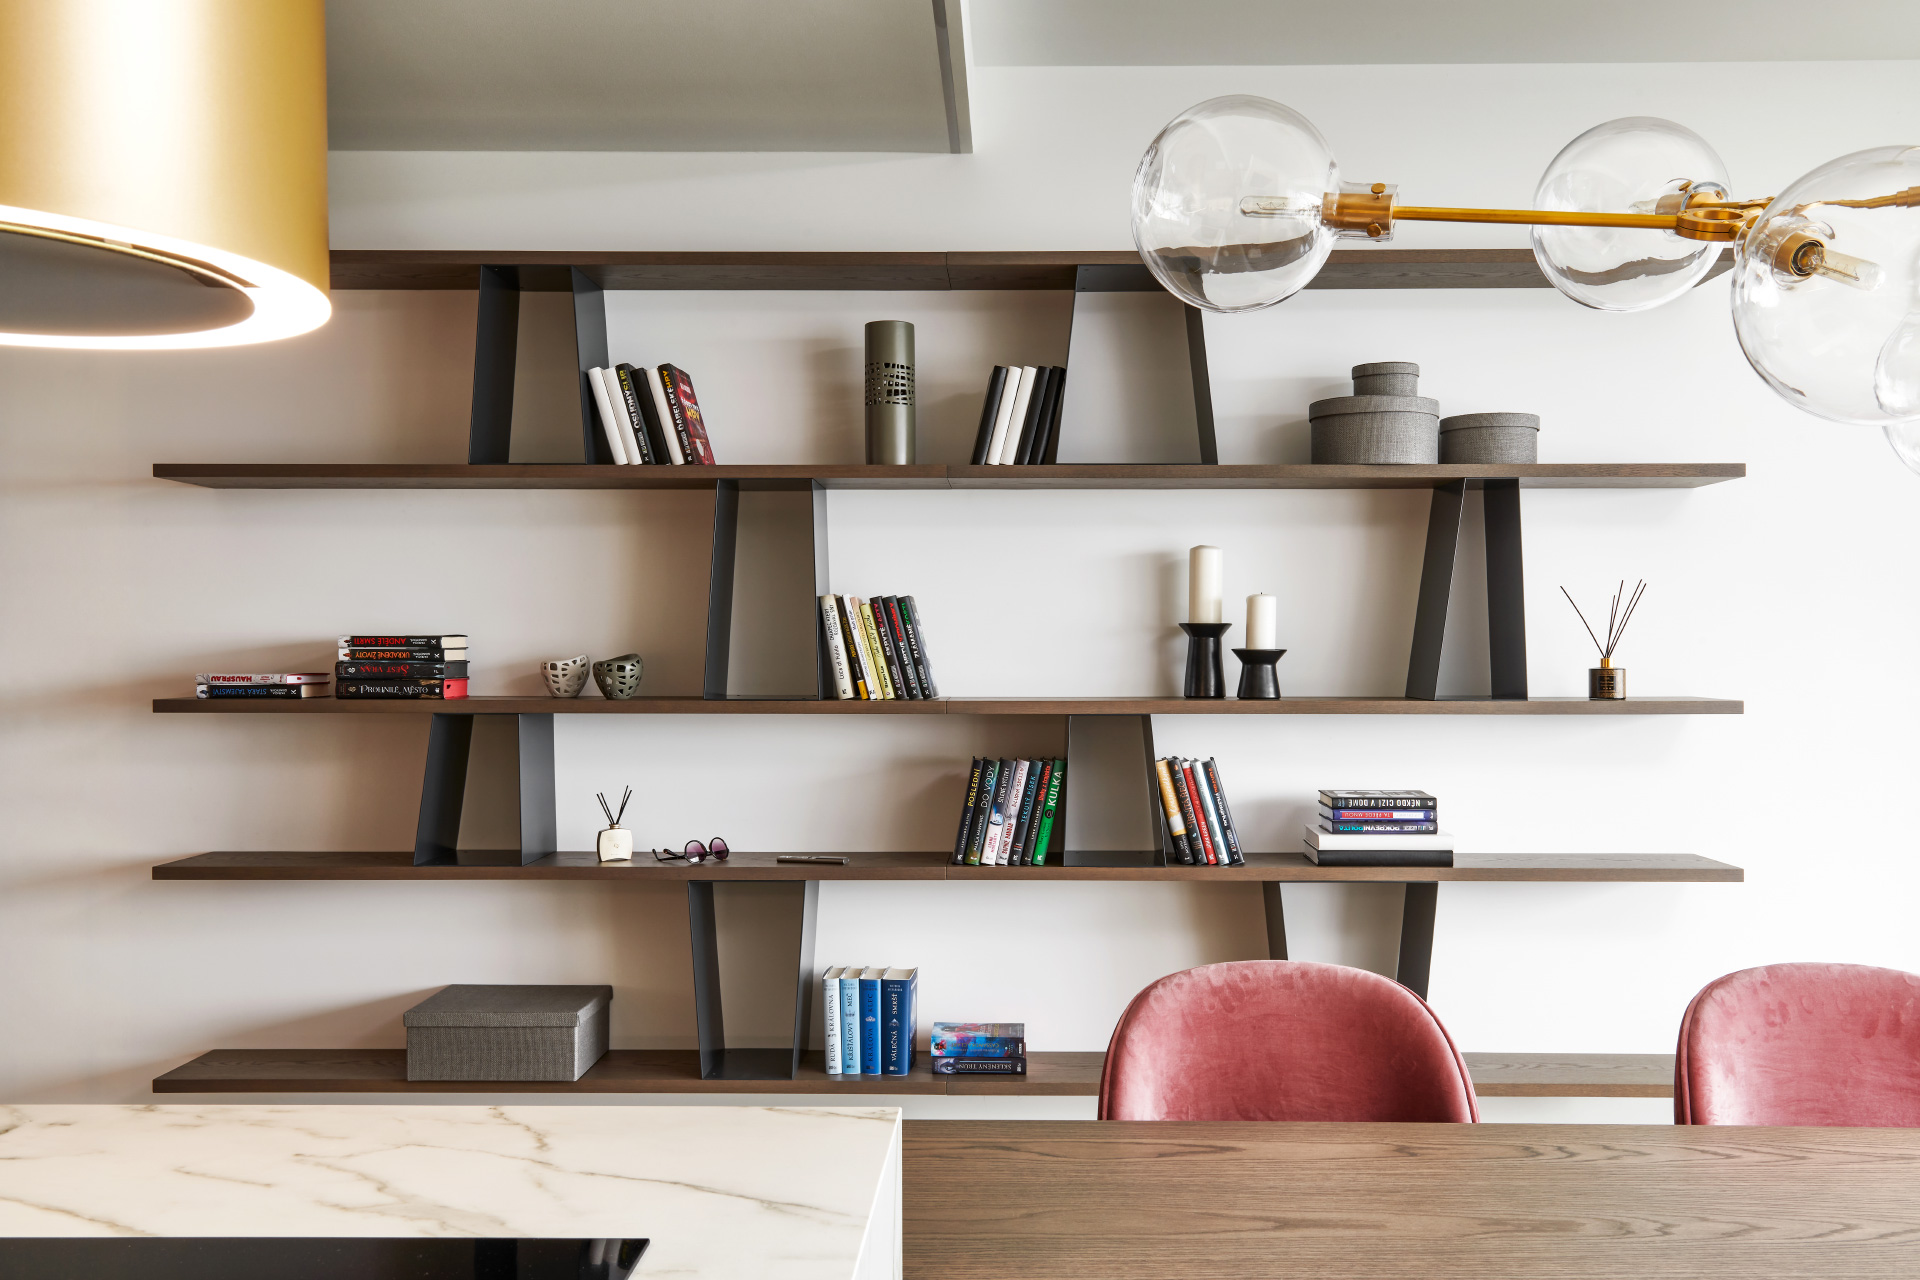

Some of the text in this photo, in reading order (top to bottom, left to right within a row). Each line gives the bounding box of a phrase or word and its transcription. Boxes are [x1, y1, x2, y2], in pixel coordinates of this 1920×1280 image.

[356, 652, 376, 660] ŽIVOTY
[378, 638, 406, 646] ANDĚLÉ
[386, 664, 410, 676] ŠEST
[968, 768, 980, 806] POSLEDNÍ
[981, 766, 994, 808] DO VODY
[1021, 776, 1036, 822] TEKUTÝ PÍSEK
[1048, 772, 1062, 806] KULKA
